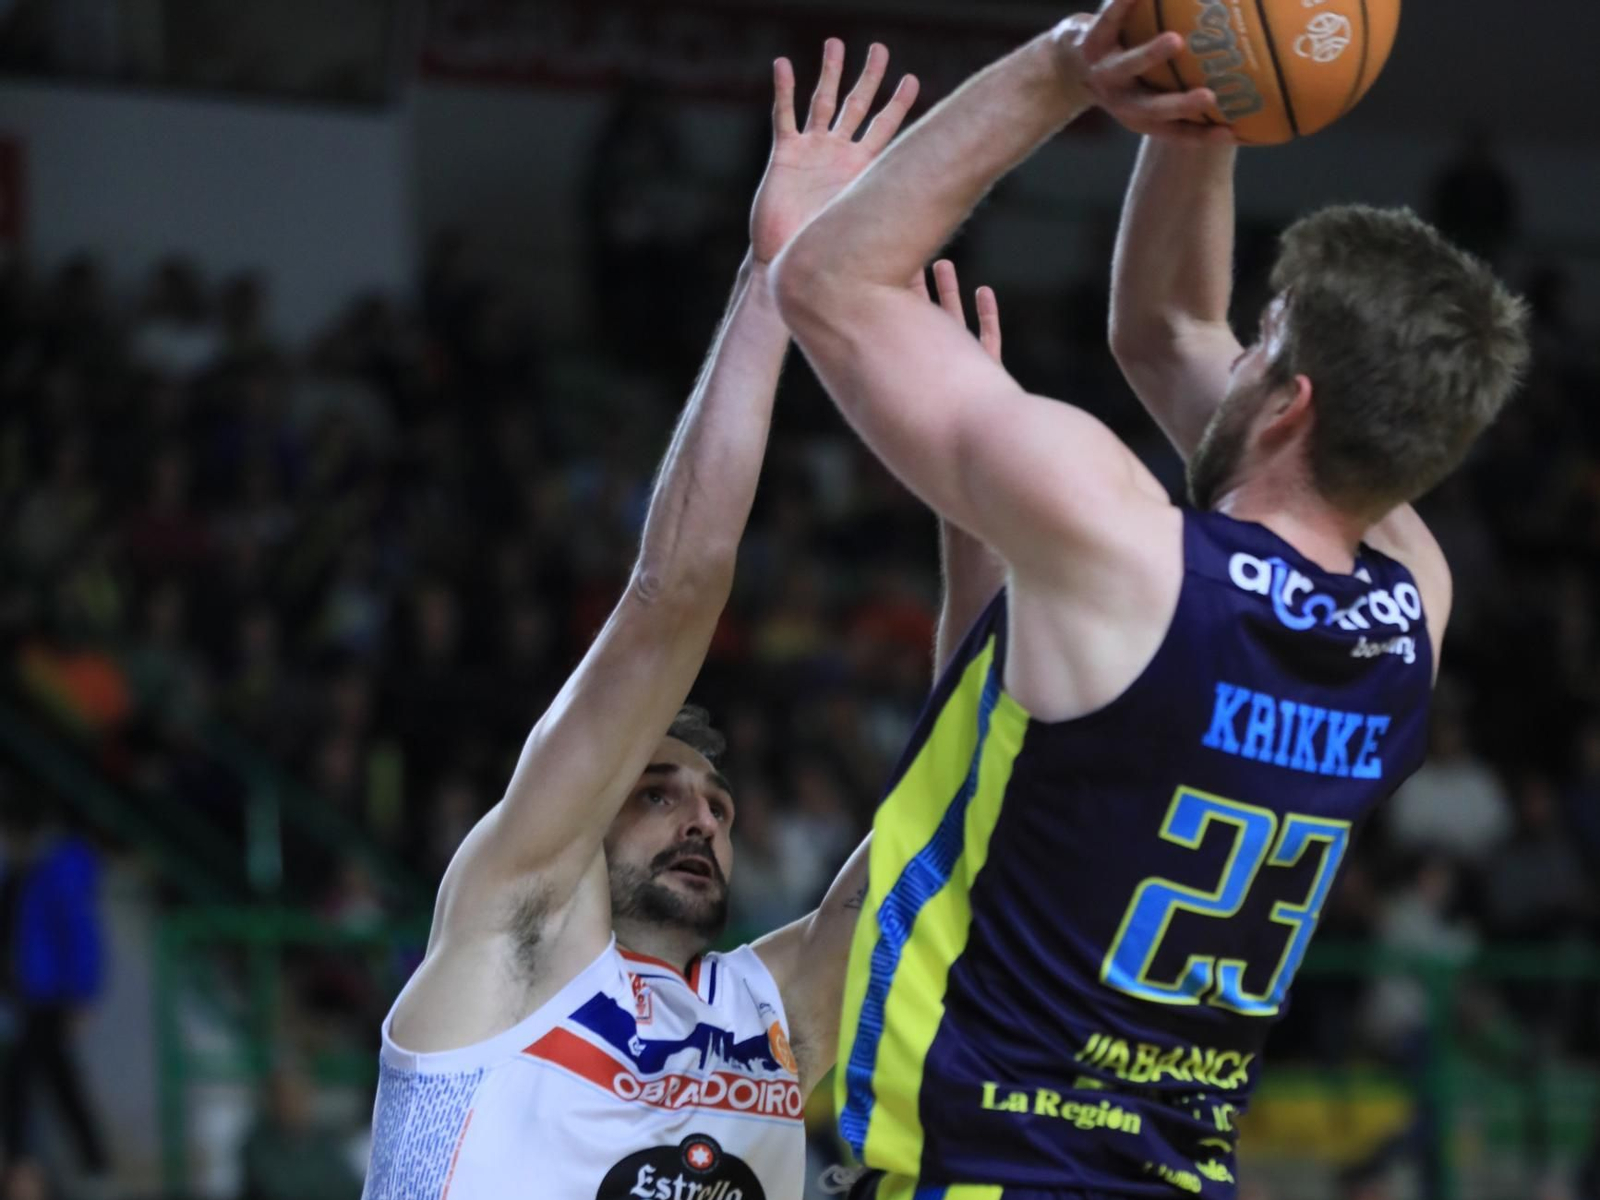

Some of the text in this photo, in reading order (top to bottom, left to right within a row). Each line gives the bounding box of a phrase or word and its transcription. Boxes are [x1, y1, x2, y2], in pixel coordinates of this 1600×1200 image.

[1201, 681, 1391, 779] KAIKKE
[1100, 785, 1352, 1015] 23
[613, 1072, 802, 1117] OBRADOIRO
[980, 1081, 1029, 1113] La
